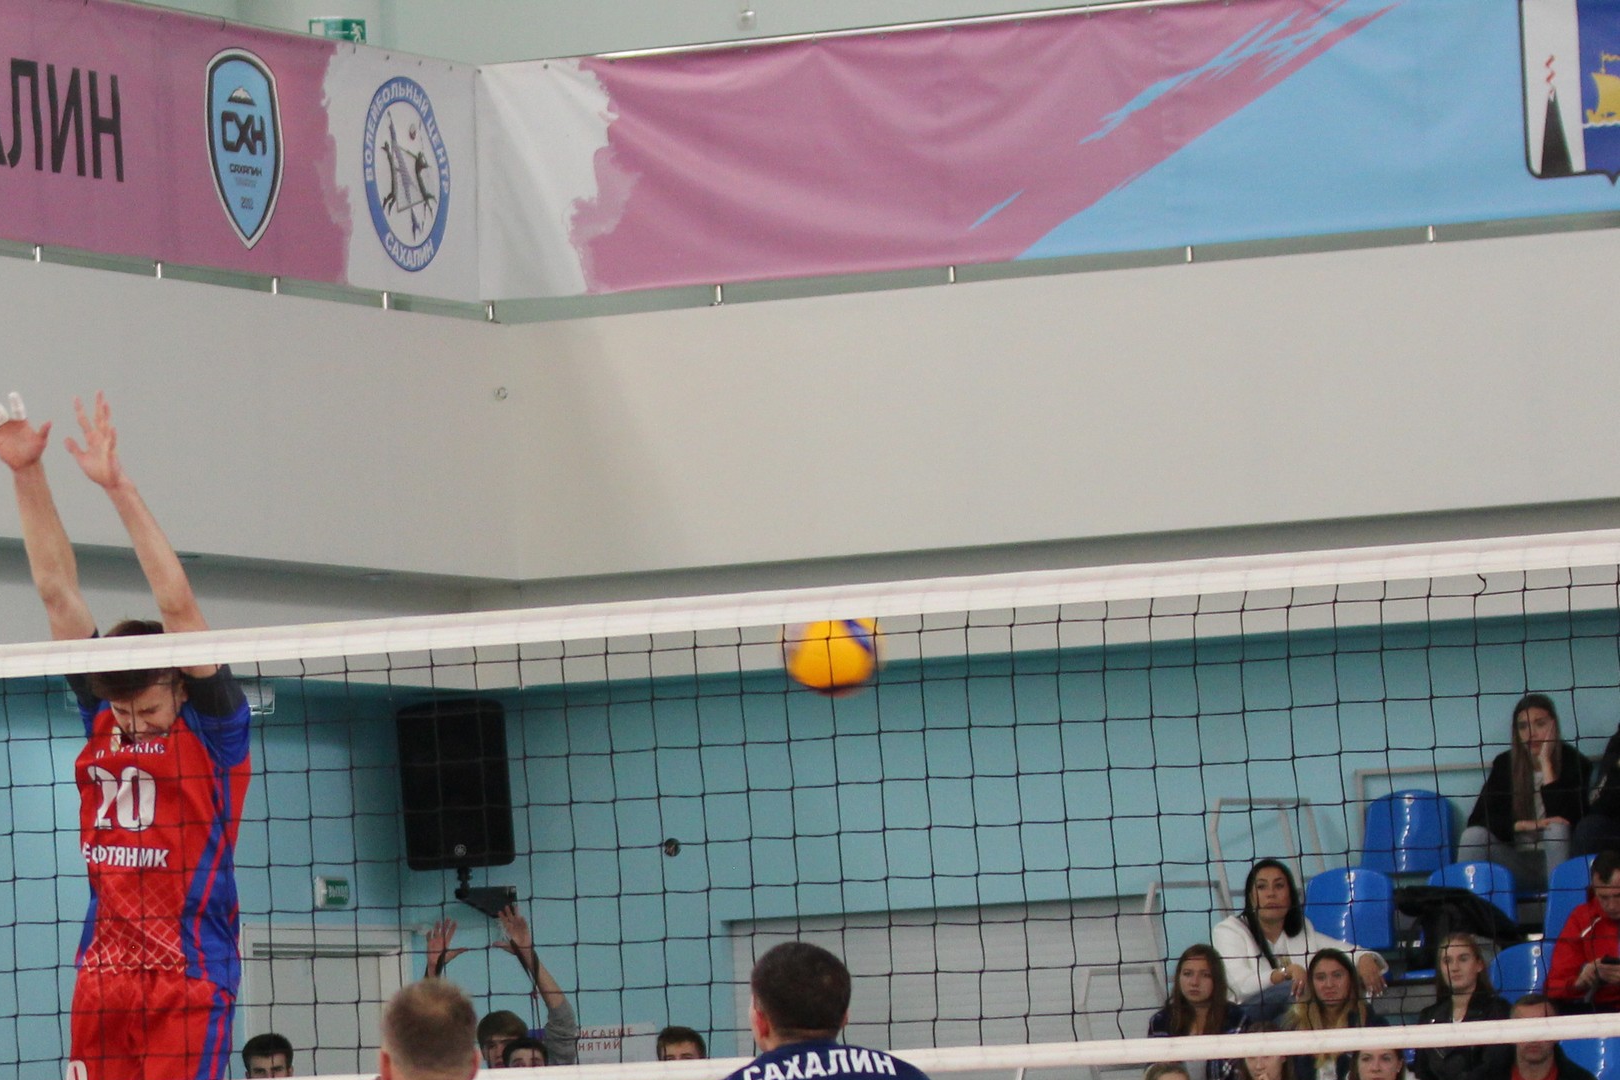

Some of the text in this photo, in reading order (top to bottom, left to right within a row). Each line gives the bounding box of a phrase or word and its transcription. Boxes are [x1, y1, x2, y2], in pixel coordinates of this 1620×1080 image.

[365, 82, 450, 194] ВОЛЕЙБОЛЬНЫЙ ЦЕНТР
[384, 231, 434, 268] САХАЛИН
[87, 765, 156, 832] 20
[82, 842, 170, 868] ЕФТЯНИК
[578, 1038, 621, 1051] НЯТИЙ
